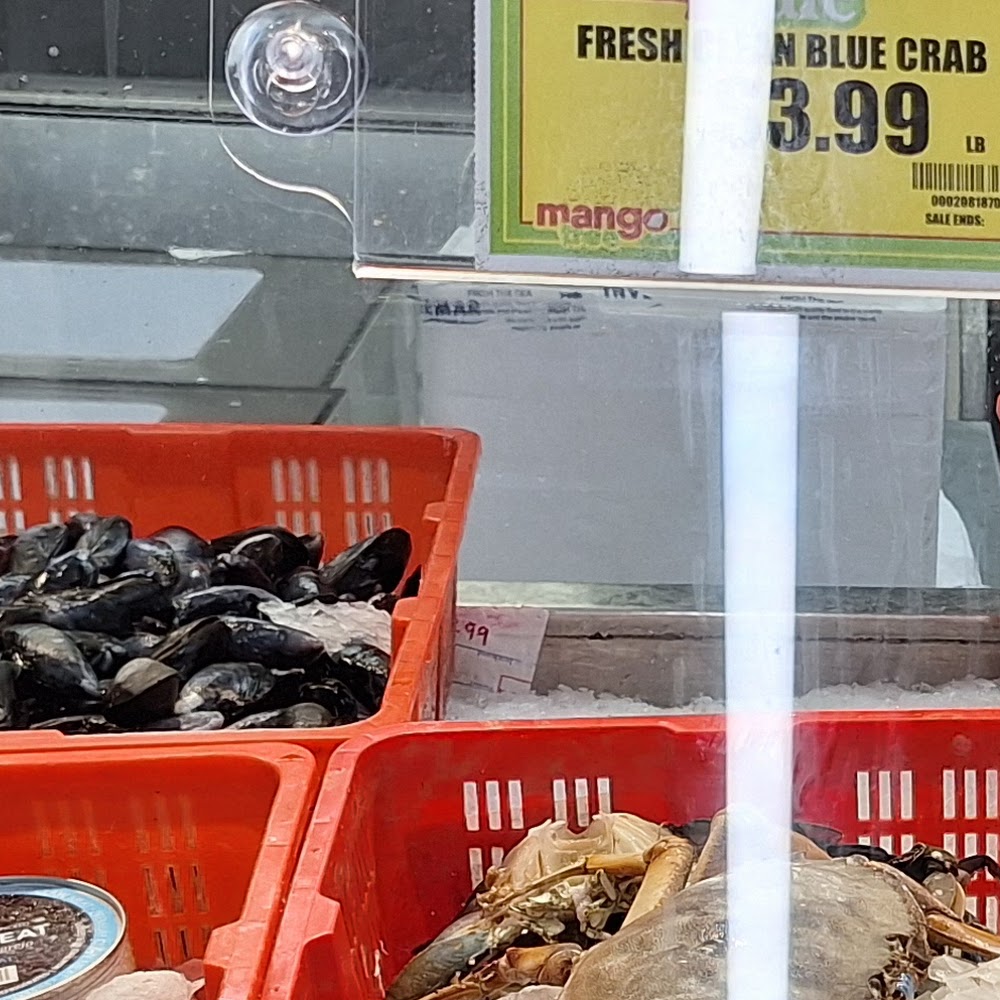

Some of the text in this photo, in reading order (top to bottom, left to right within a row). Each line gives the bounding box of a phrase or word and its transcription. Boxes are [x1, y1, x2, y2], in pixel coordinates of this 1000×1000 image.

[577, 24, 683, 63] FRESH
[806, 33, 887, 71] BLUE
[895, 37, 987, 74] CRAB
[768, 77, 930, 156] 3.99
[966, 135, 986, 153] LB
[537, 203, 669, 240] mango
[925, 213, 985, 227] SALE ENDS:
